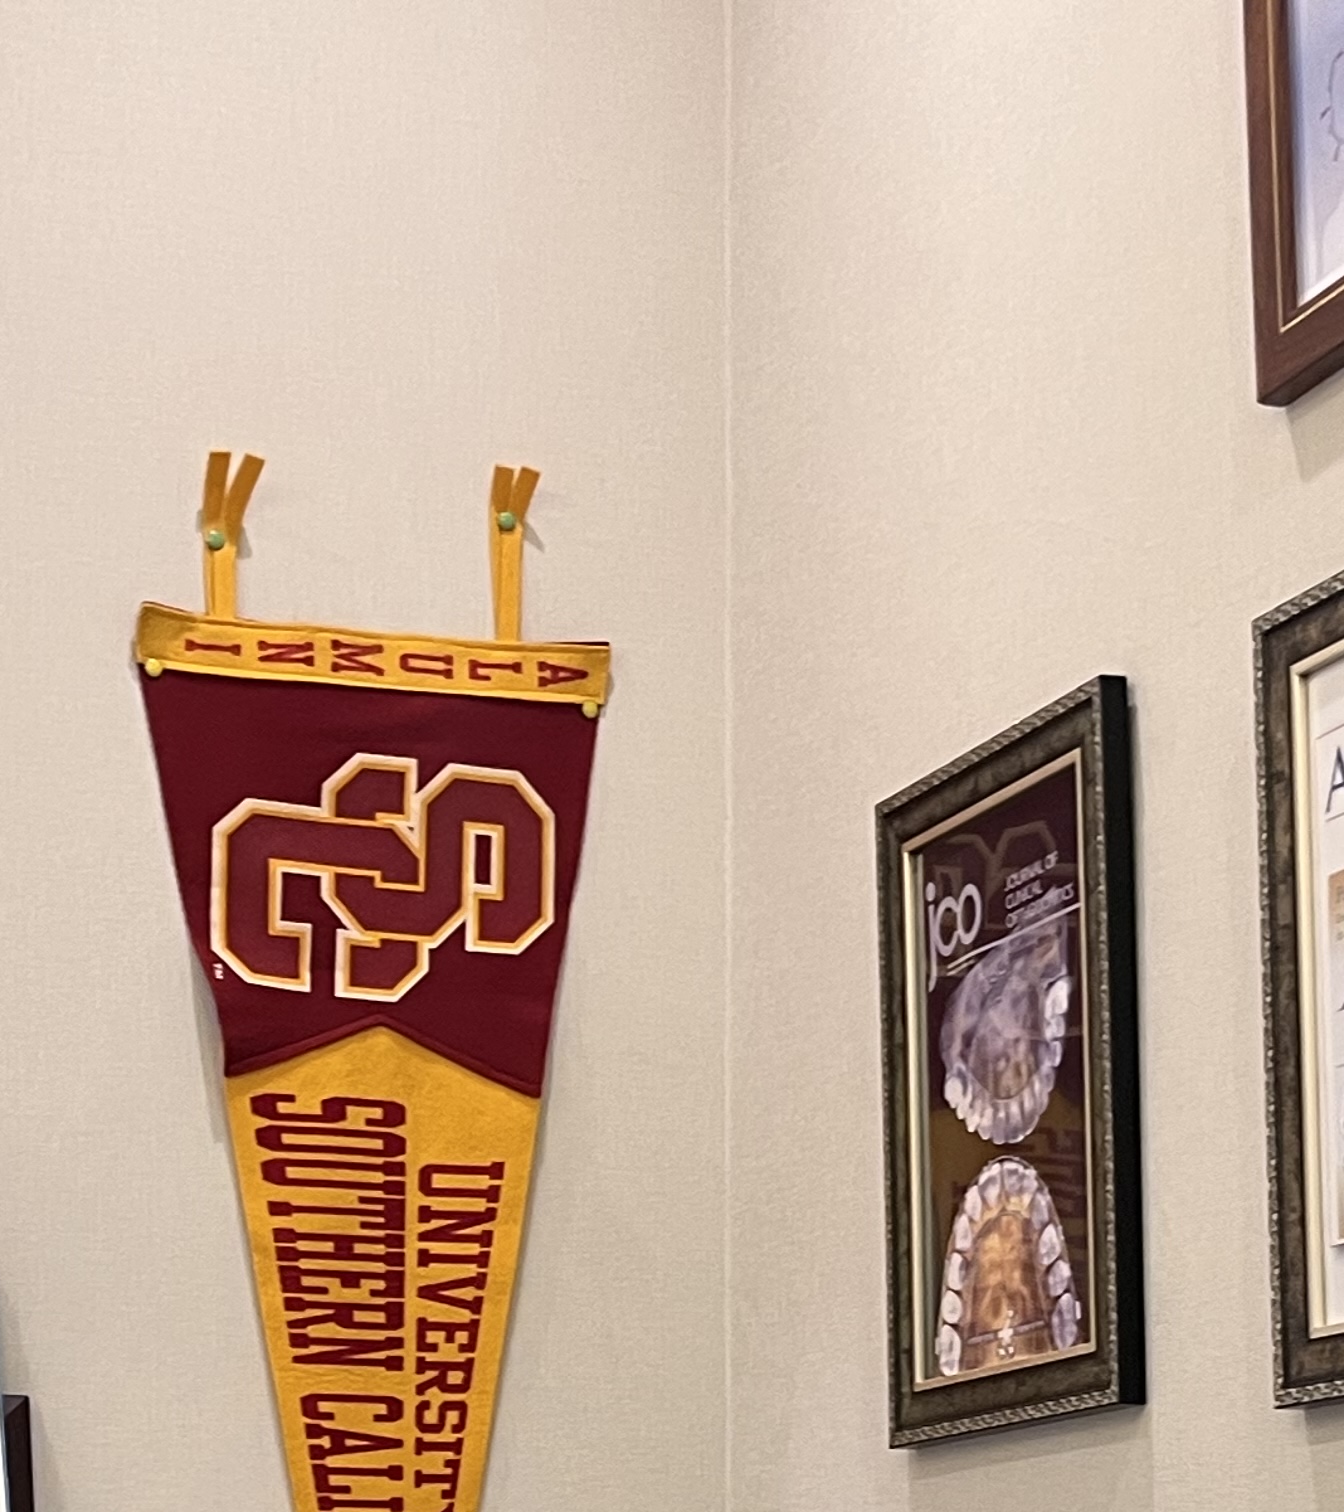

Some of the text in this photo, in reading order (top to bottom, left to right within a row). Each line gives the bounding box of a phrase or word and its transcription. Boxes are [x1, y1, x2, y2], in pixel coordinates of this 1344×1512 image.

[184, 638, 588, 688] ALUMNI
[1004, 850, 1059, 892] JOURNAL OF
[925, 882, 981, 993] jco
[249, 1092, 408, 1373] SOUTHERN
